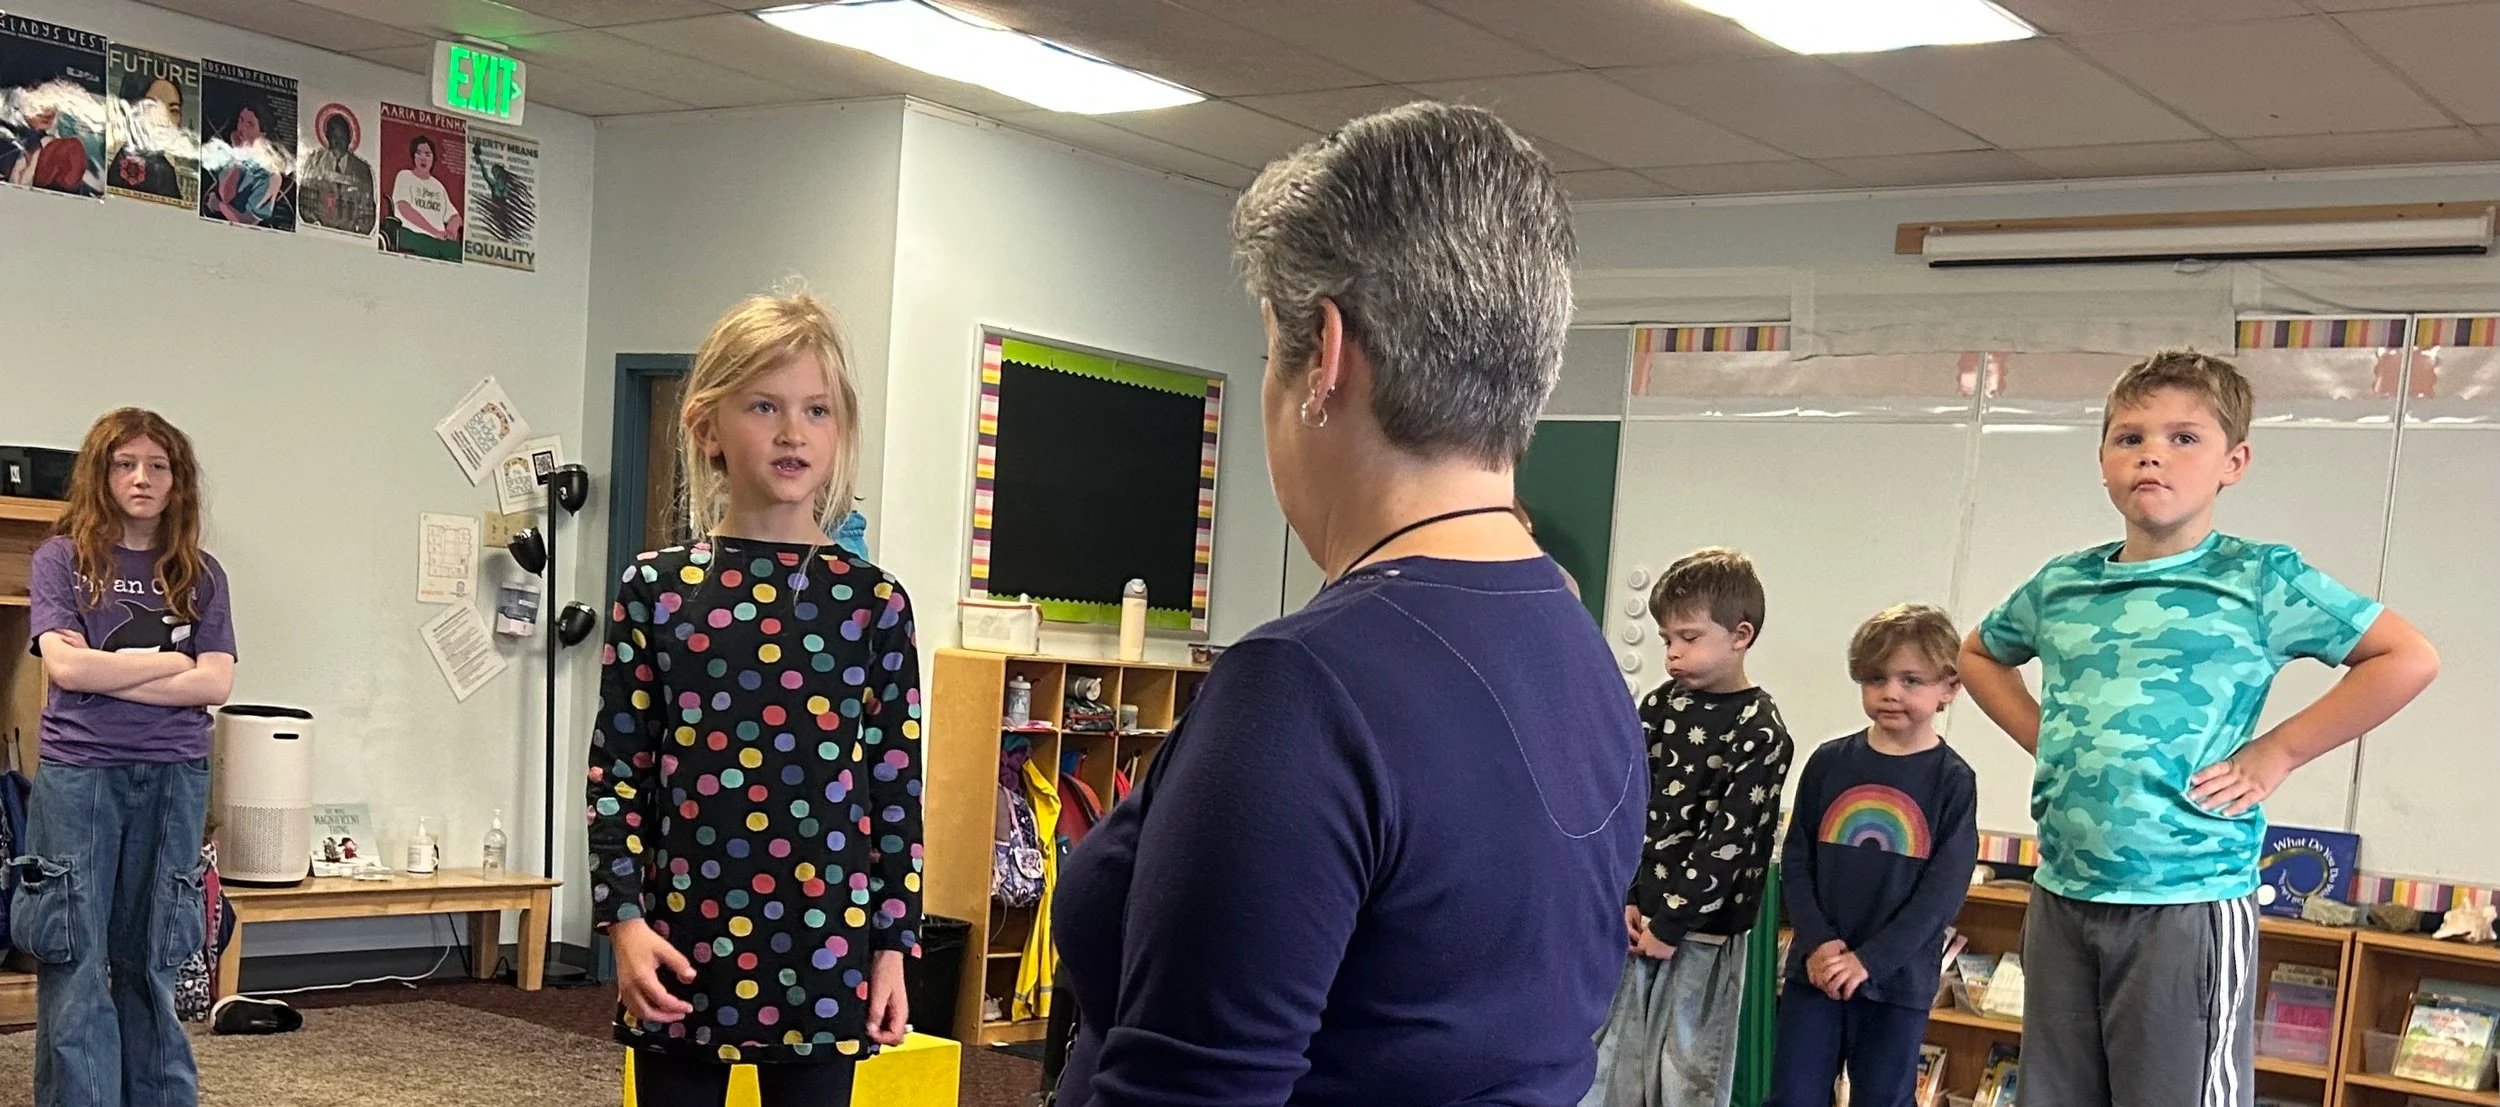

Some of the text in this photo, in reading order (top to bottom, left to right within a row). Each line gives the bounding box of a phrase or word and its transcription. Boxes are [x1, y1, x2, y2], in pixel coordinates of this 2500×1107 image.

[67, 30, 107, 51] WEST
[109, 49, 198, 88] FUTURE
[448, 46, 516, 118] EXIT
[381, 104, 416, 121] MARIA
[419, 112, 432, 124] DA
[435, 115, 467, 132] PENHA
[467, 135, 505, 152] LIBERTY
[506, 143, 538, 159] MEANS
[464, 240, 535, 265] EQUALITY
[114, 579, 144, 594] an
[313, 815, 360, 825] MAGNIFICENT
[2273, 837, 2305, 852] What
[2308, 838, 2323, 852] Do
[2329, 867, 2339, 883] Do
